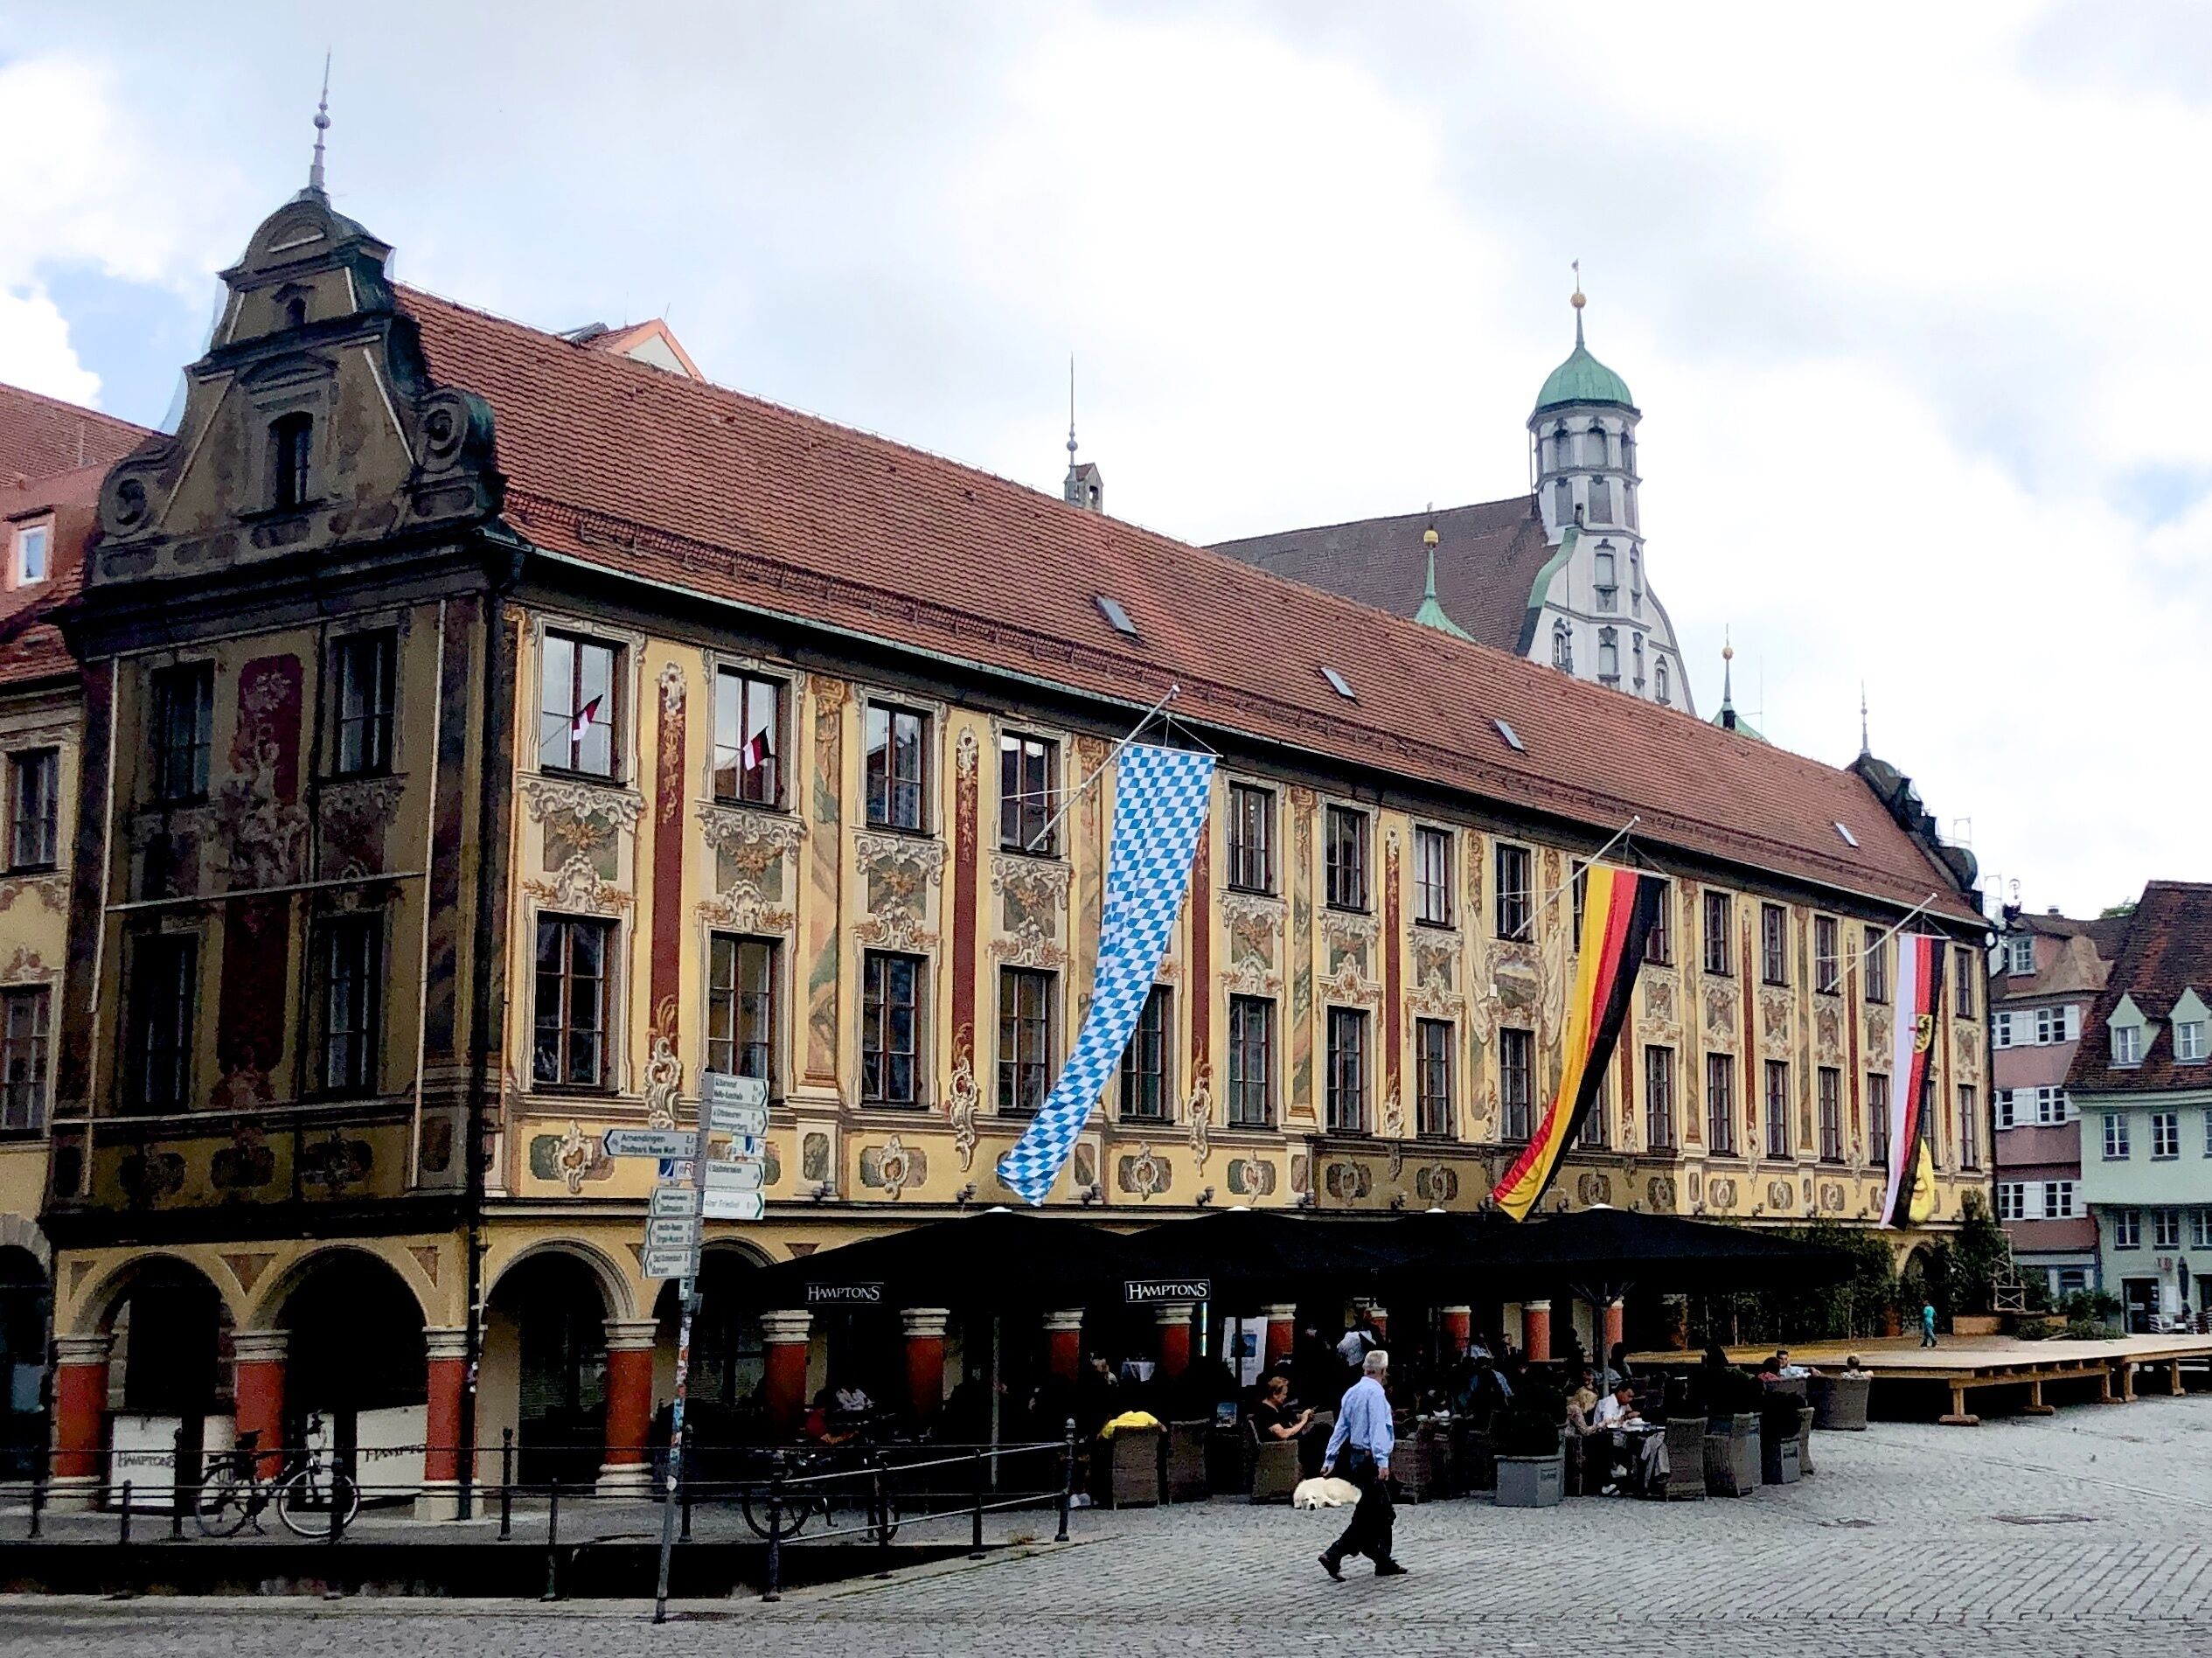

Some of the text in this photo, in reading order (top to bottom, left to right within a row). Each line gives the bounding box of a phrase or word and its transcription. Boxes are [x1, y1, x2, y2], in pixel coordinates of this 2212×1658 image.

[621, 1133, 665, 1144] Amendingen
[807, 1285, 881, 1301] HAMPTONS
[1128, 1282, 1208, 1299] HAMPTONS
